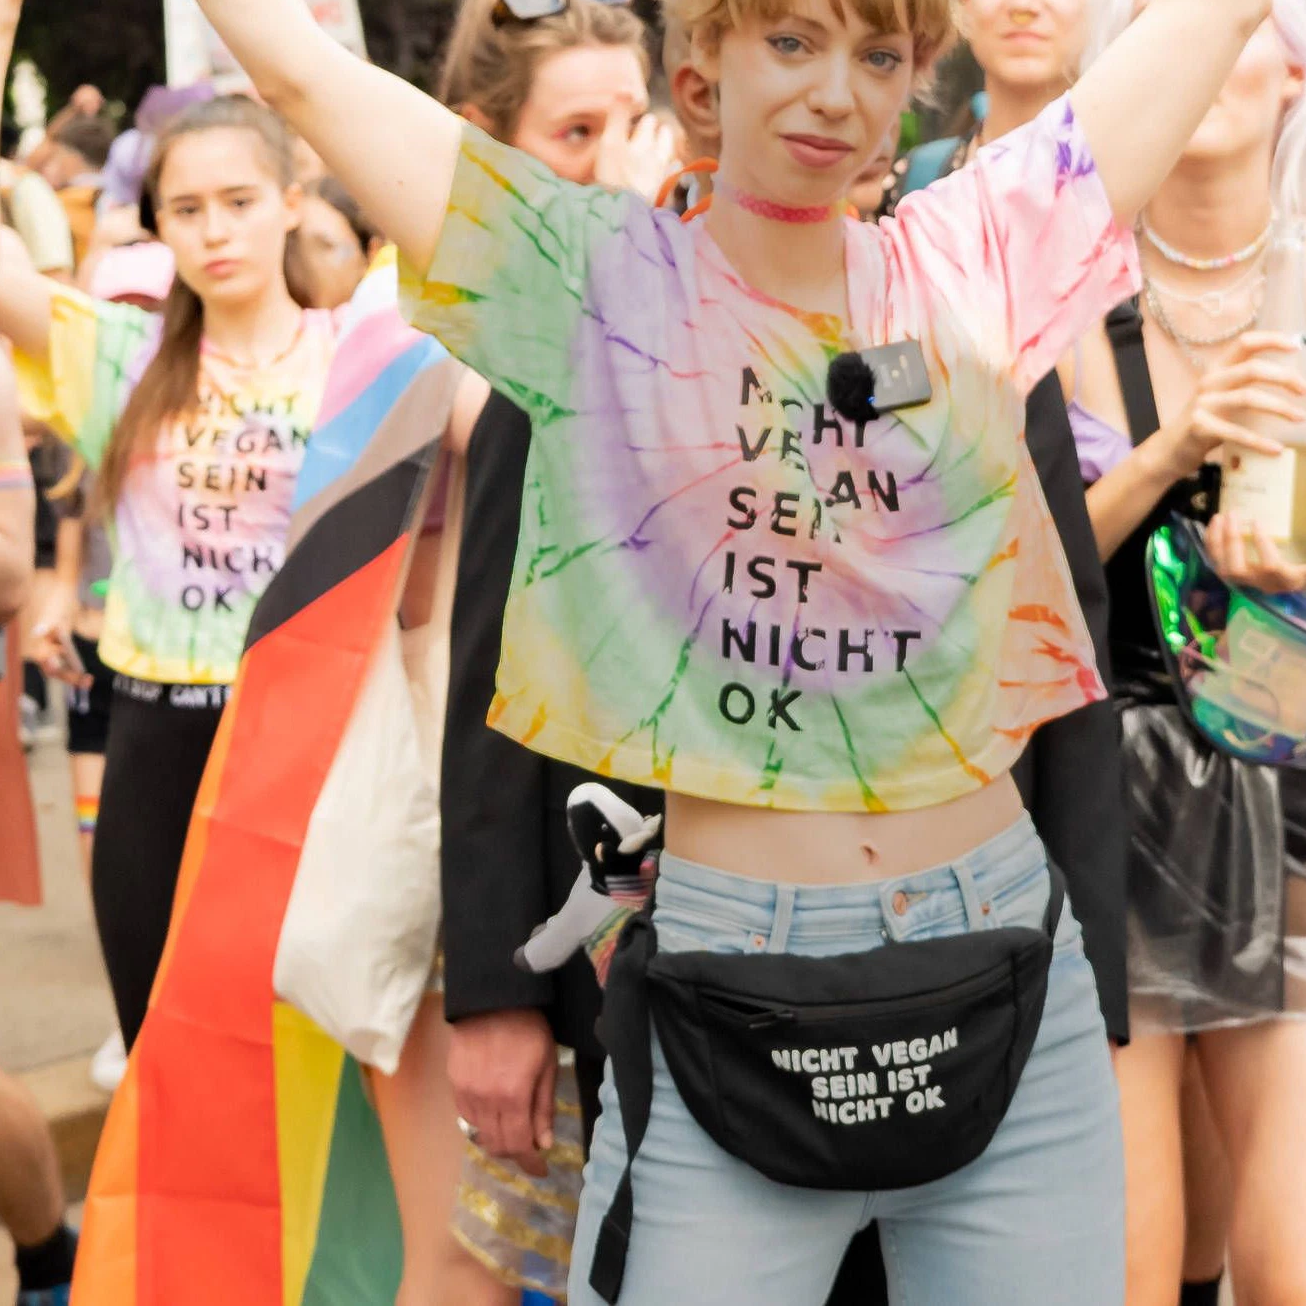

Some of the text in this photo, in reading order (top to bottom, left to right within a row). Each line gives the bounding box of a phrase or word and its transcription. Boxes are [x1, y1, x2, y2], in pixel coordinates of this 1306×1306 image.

[185, 425, 311, 454] VEGAN
[178, 462, 267, 492] SEIN
[178, 504, 238, 531] IST
[183, 543, 276, 574] NICH
[722, 551, 823, 604] IST
[181, 584, 233, 612] OK
[722, 619, 921, 673] NICHT
[718, 682, 803, 731] OK
[771, 1027, 958, 1073] NICHT VEGAN
[811, 1064, 932, 1099] SEIN IST
[812, 1085, 947, 1125] NICHT OK
